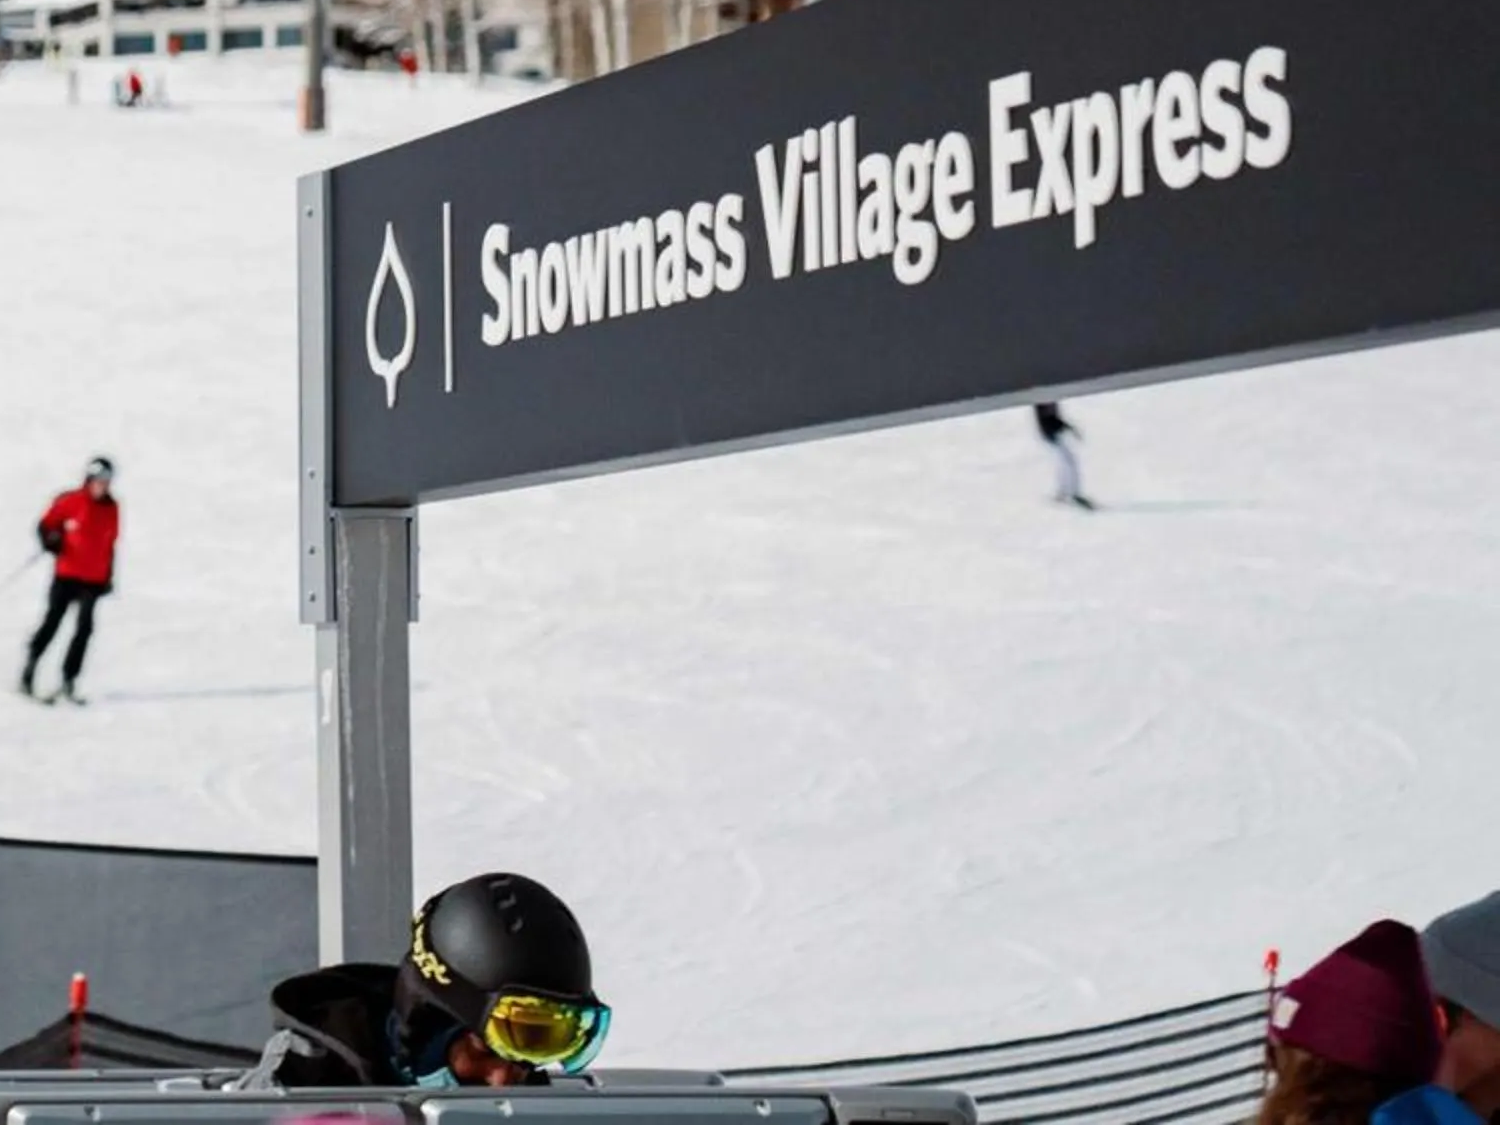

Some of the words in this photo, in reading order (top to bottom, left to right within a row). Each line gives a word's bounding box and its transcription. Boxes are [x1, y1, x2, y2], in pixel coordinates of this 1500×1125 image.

[481, 192, 746, 348] Snowmass
[755, 115, 974, 285] Village
[989, 46, 1290, 249] Express
